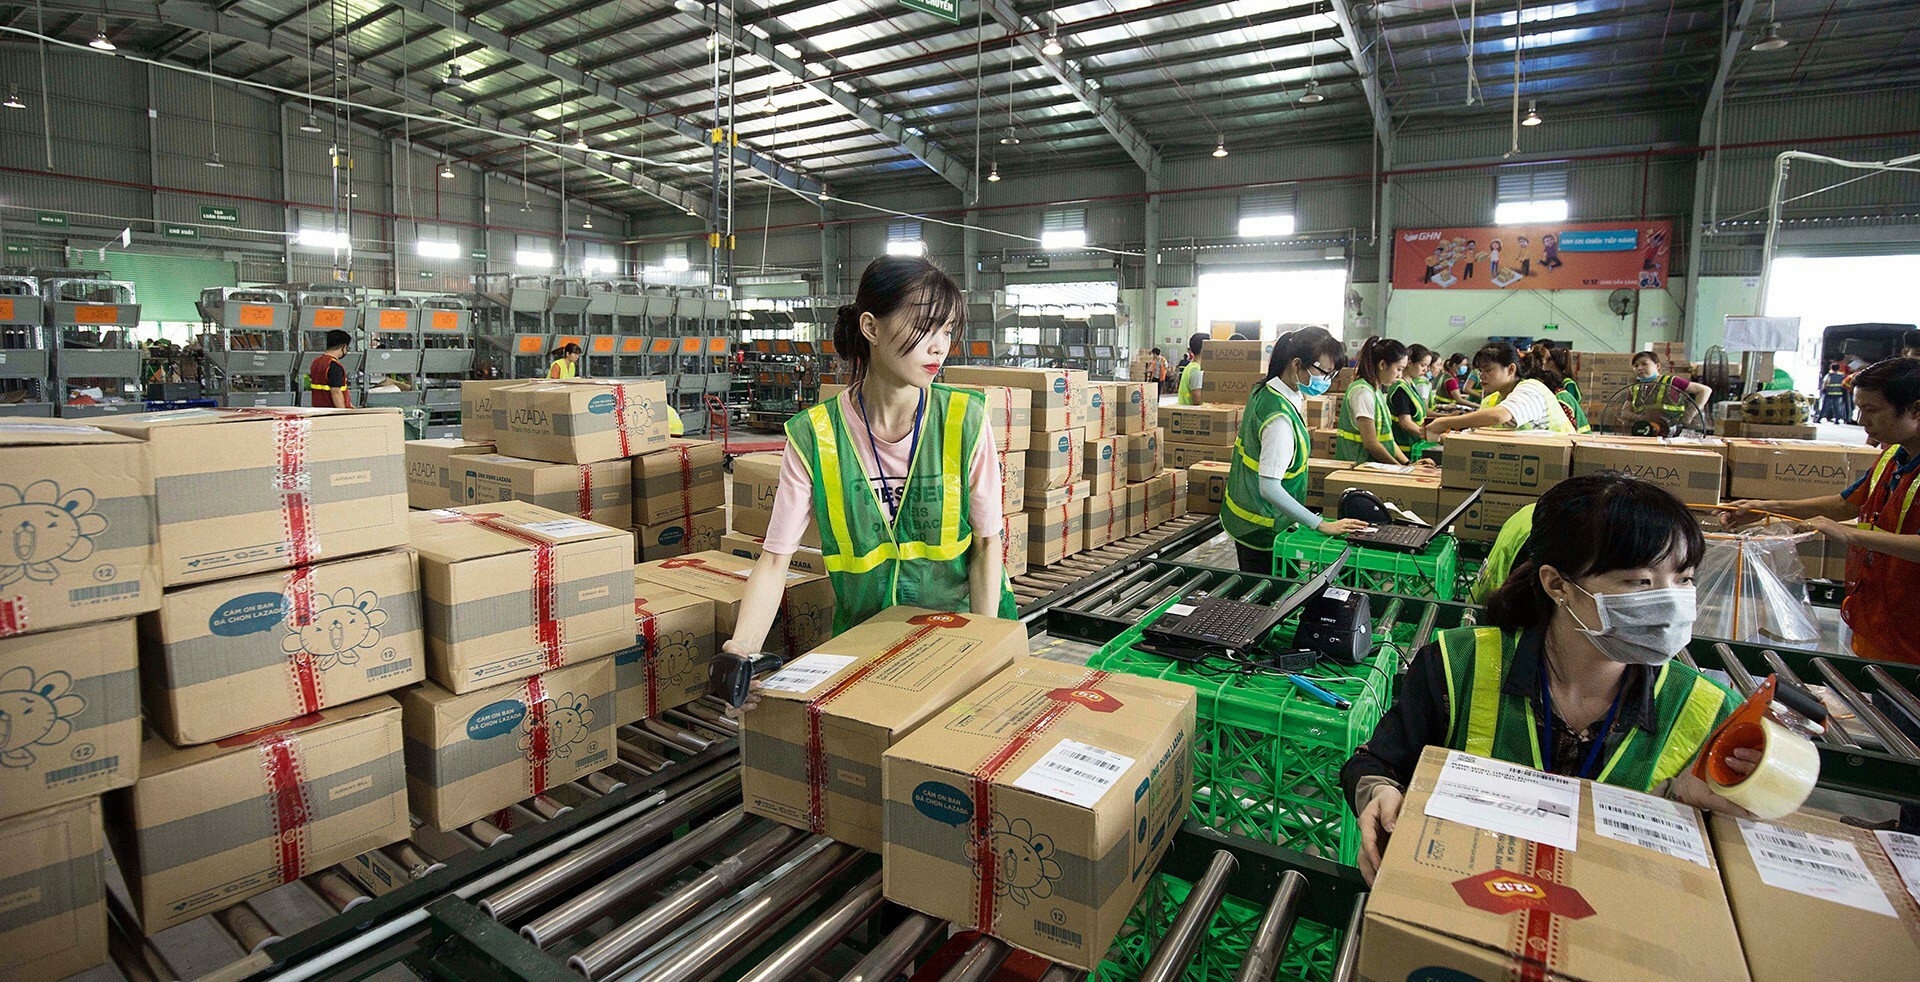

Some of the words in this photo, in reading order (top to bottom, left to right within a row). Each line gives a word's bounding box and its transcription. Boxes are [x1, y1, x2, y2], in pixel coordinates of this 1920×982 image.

[1418, 232, 1442, 240] GHN
[510, 409, 549, 426] LAZADA
[409, 461, 437, 478] LAZADA
[1775, 462, 1847, 479] LAZADA
[790, 560, 812, 569] AZADA
[98, 568, 113, 578] 12
[383, 650, 394, 659] 12
[498, 712, 522, 724] LAZADA
[75, 746, 91, 758] 12
[943, 803, 969, 816] LAZADA
[1498, 802, 1548, 818] GHN
[1492, 881, 1535, 894] 12.12
[1053, 912, 1064, 921] 12
